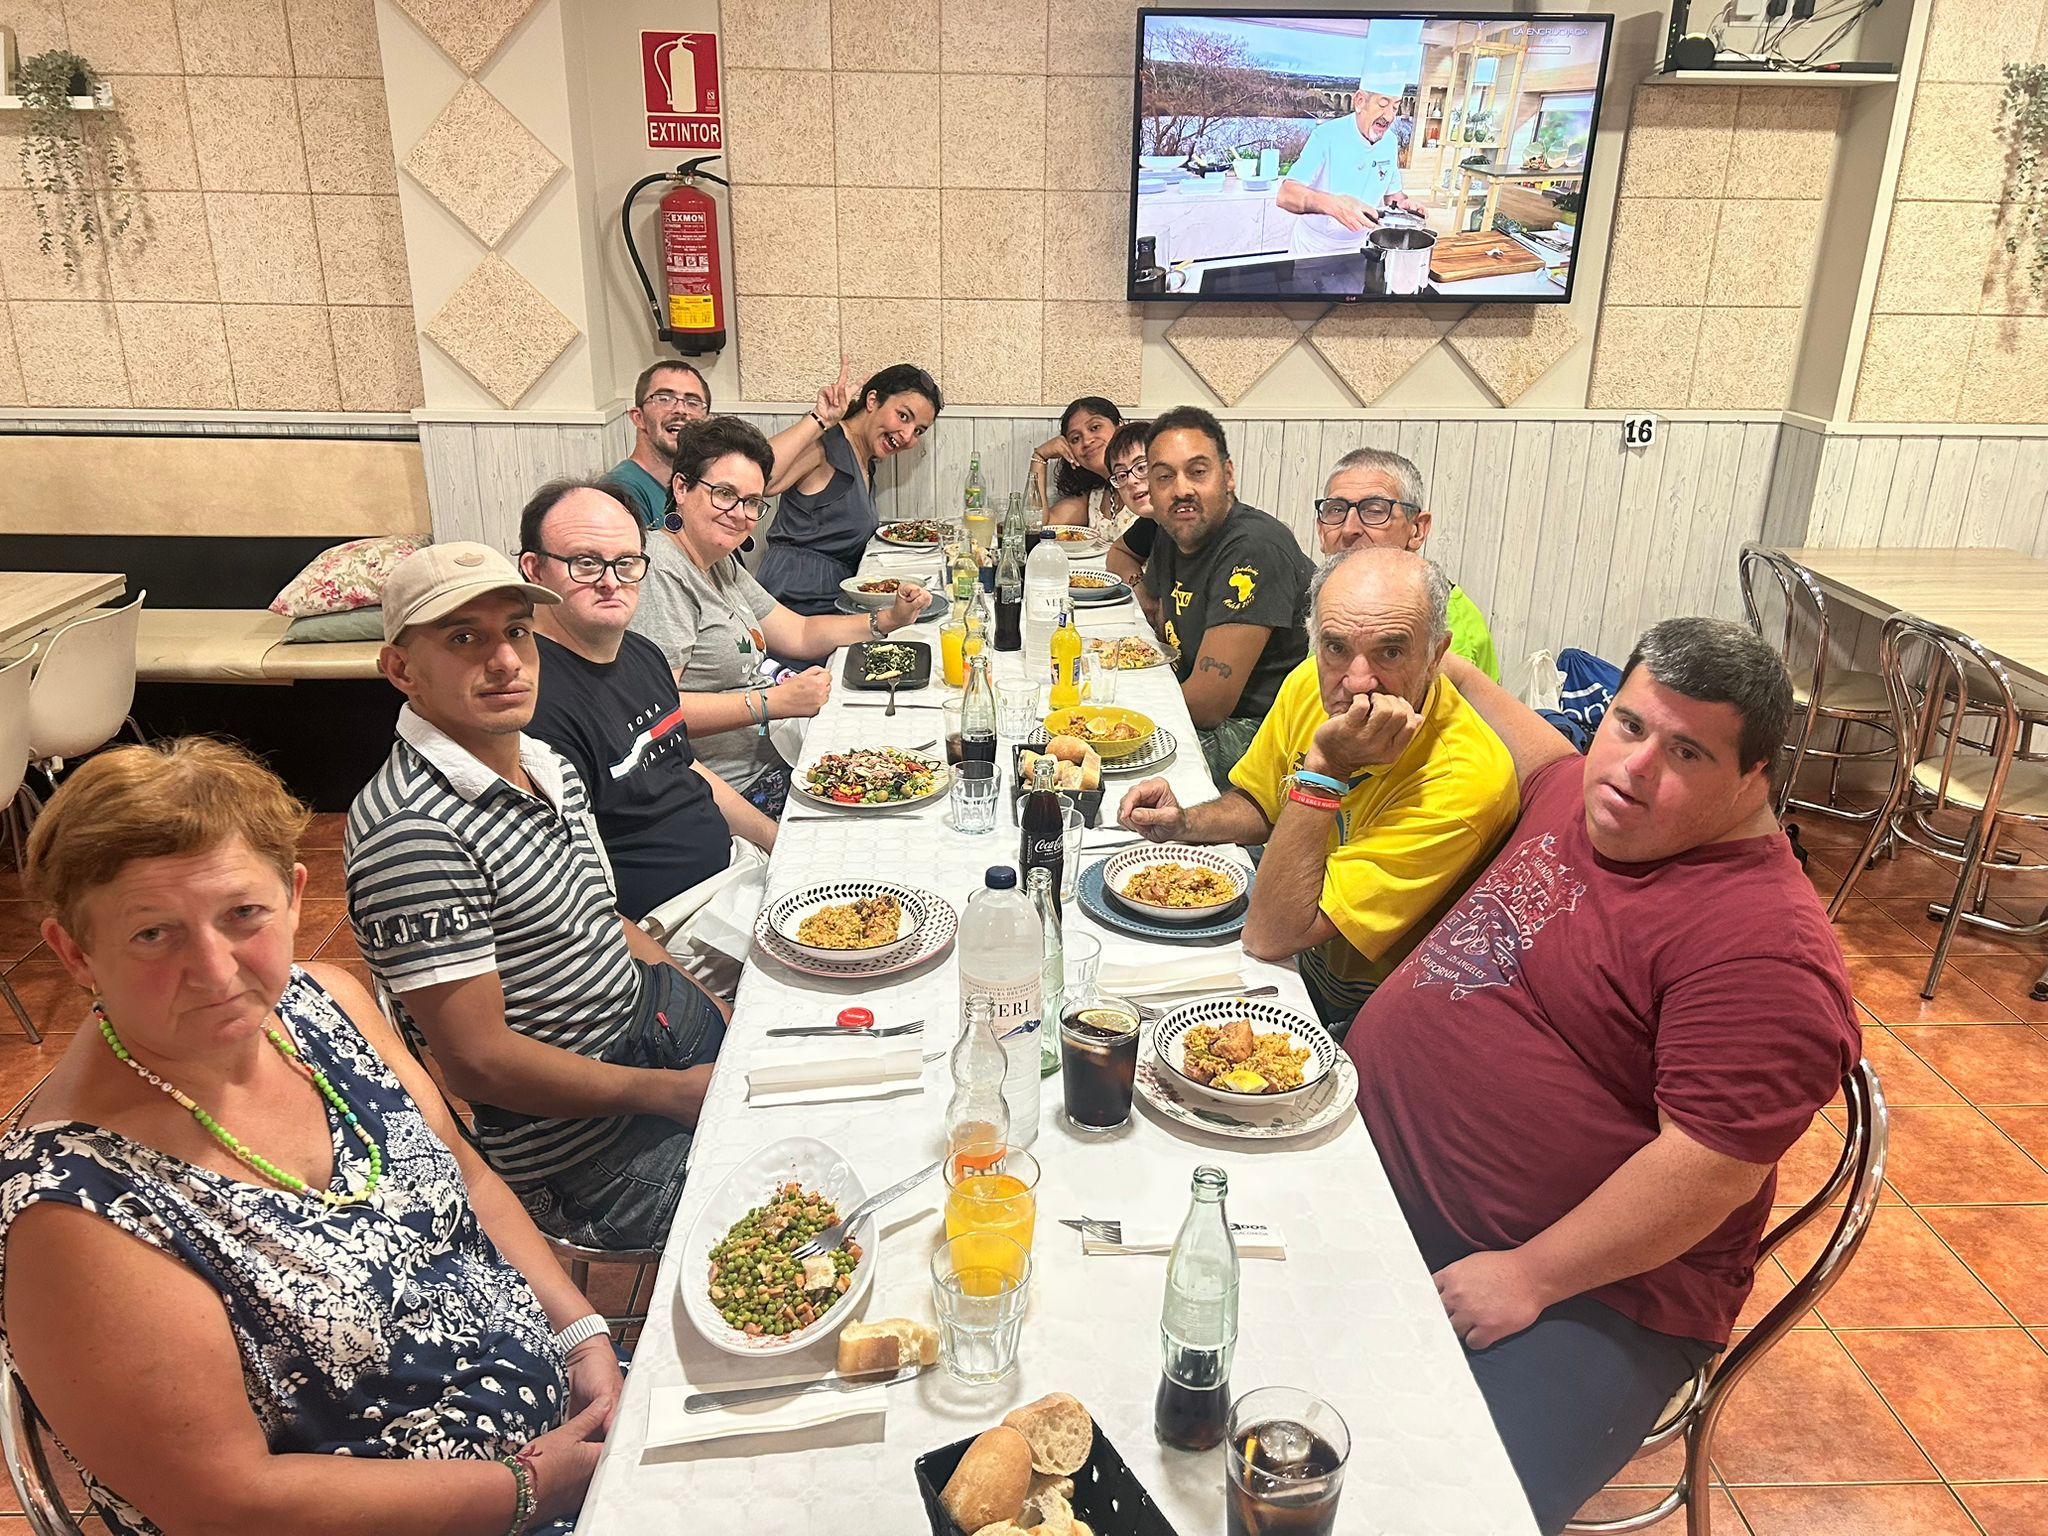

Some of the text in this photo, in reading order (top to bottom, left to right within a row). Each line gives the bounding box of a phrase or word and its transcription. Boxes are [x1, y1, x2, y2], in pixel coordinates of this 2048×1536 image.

[649, 122, 721, 142] EXTINTOR
[671, 214, 704, 222] EXMON
[1626, 419, 1653, 443] 16
[642, 733, 682, 771] ITALIA
[1420, 953, 1461, 982] CALIFORNIA
[998, 999, 1030, 1017] ERI
